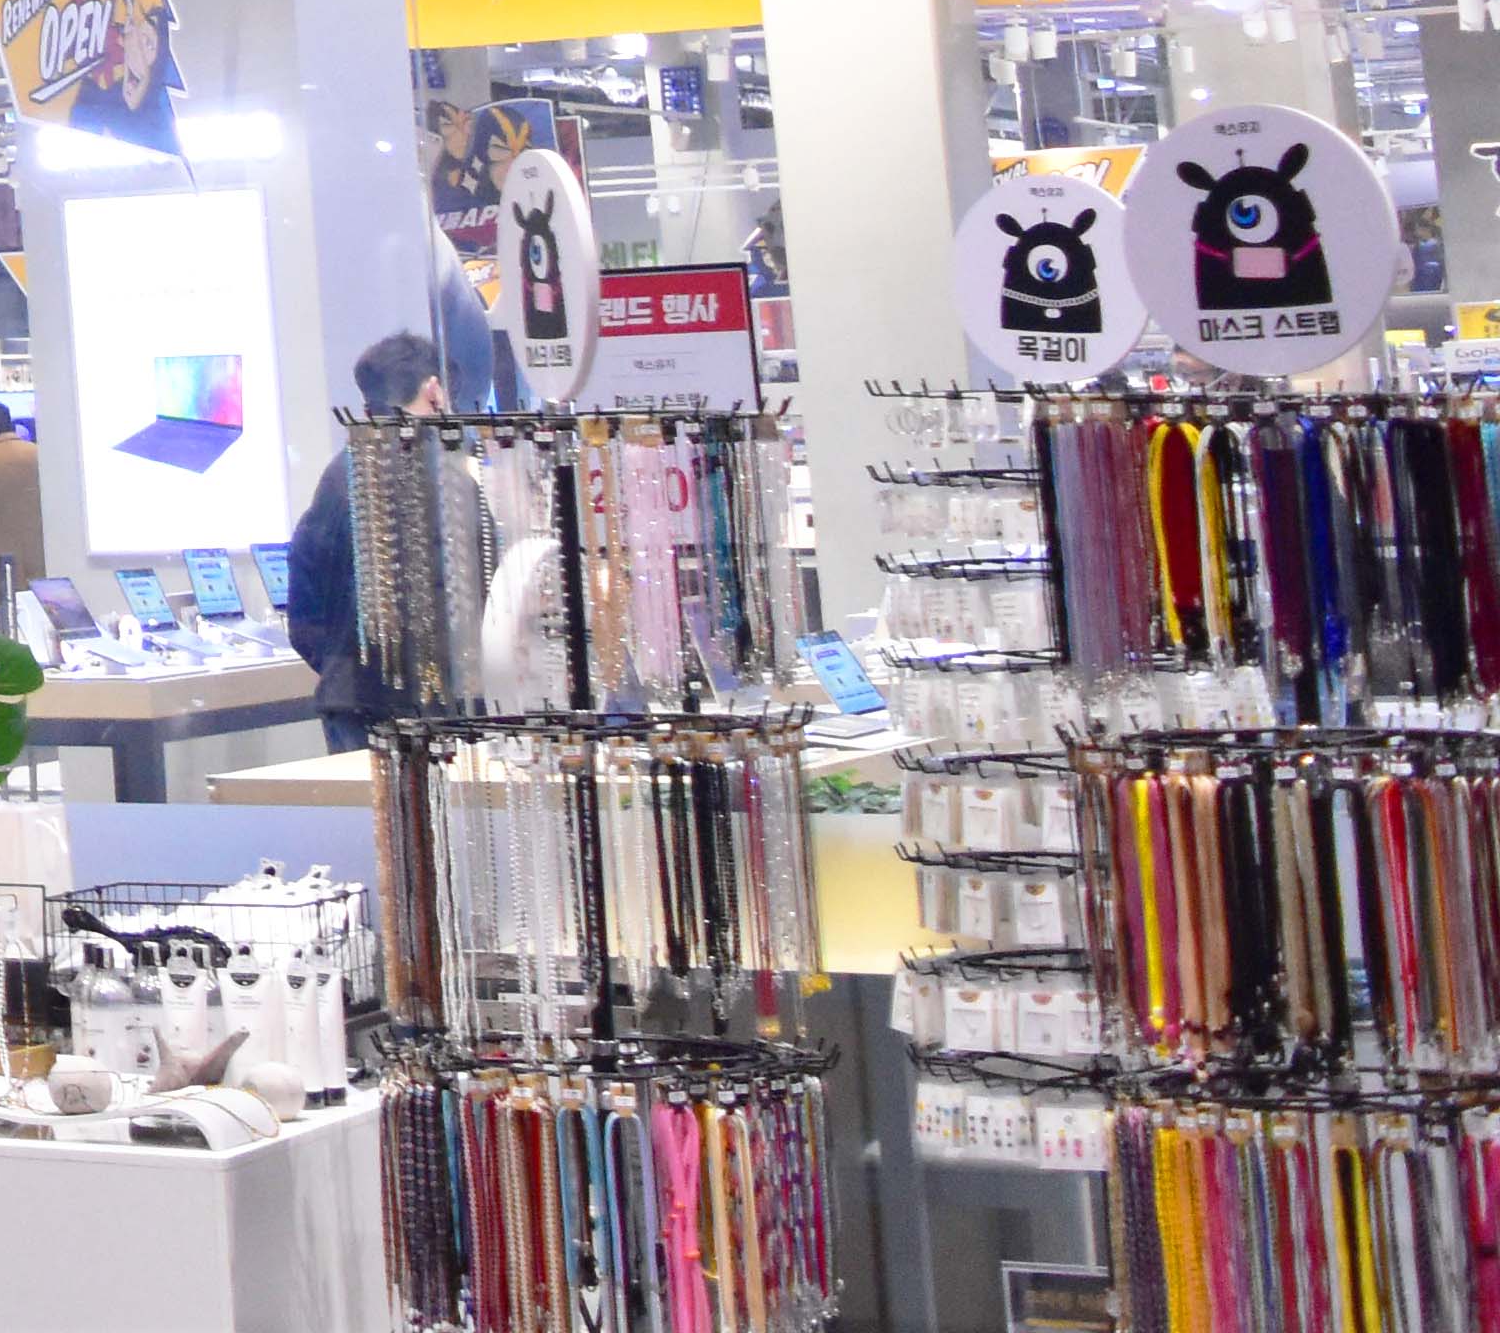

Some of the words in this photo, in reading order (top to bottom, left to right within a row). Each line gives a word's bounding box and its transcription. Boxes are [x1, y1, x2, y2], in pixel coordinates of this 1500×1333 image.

[661, 293, 719, 324] 행사
[1199, 313, 1266, 343] 마스크
[1274, 310, 1342, 336] 스트랩
[1017, 335, 1087, 363] 목걸이
